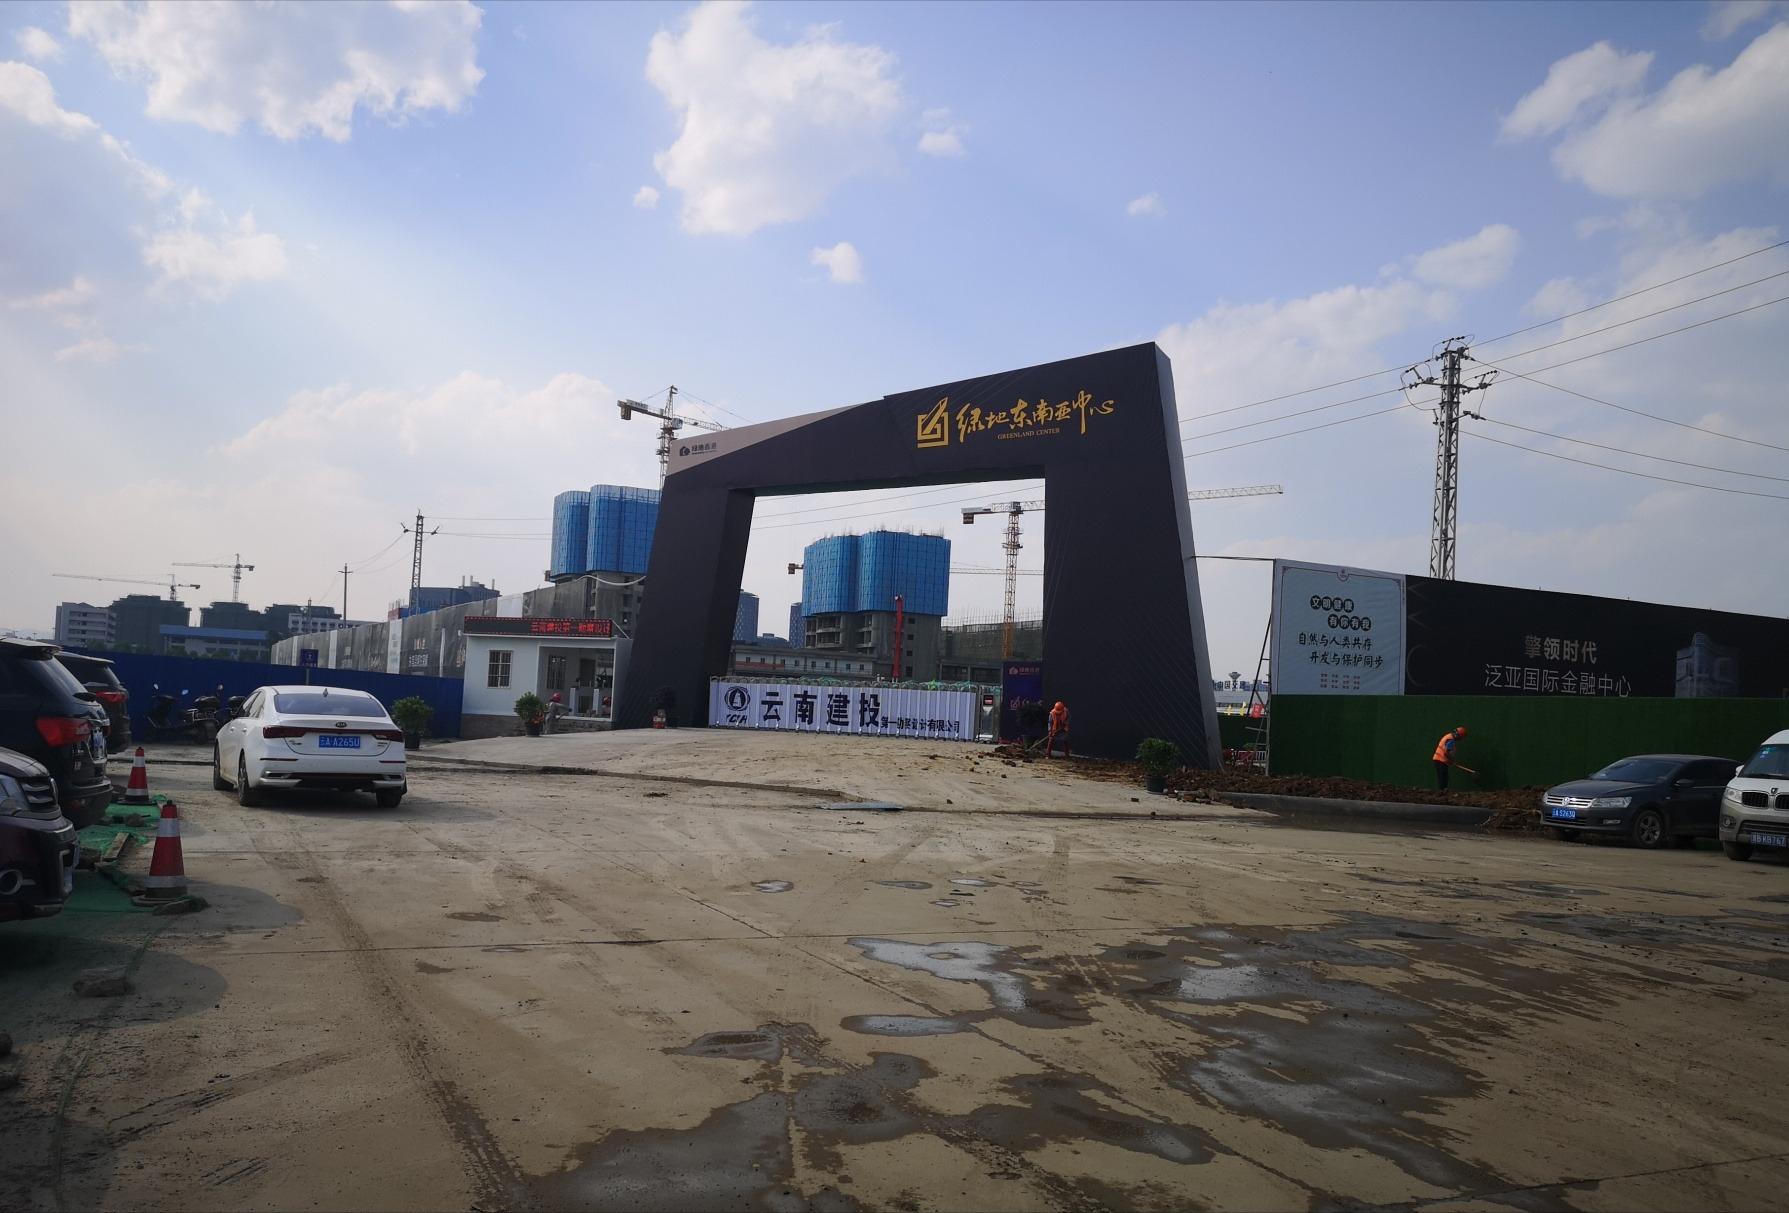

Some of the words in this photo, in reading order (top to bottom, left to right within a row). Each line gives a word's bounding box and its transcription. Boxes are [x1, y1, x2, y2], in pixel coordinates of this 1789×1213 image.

[955, 390, 1114, 443] 绿地东南亚中心
[997, 430, 1034, 440] GREENLAND
[1036, 427, 1060, 436] CENTER
[1328, 614, 1371, 631] 有你有我
[1297, 632, 1373, 651] 自然与人类共存
[1524, 634, 1598, 664] 擎领时代
[1310, 651, 1384, 669] 开发与保护同步
[1484, 663, 1632, 698] 泛亚国际金融中心
[761, 690, 881, 728] 云南建投
